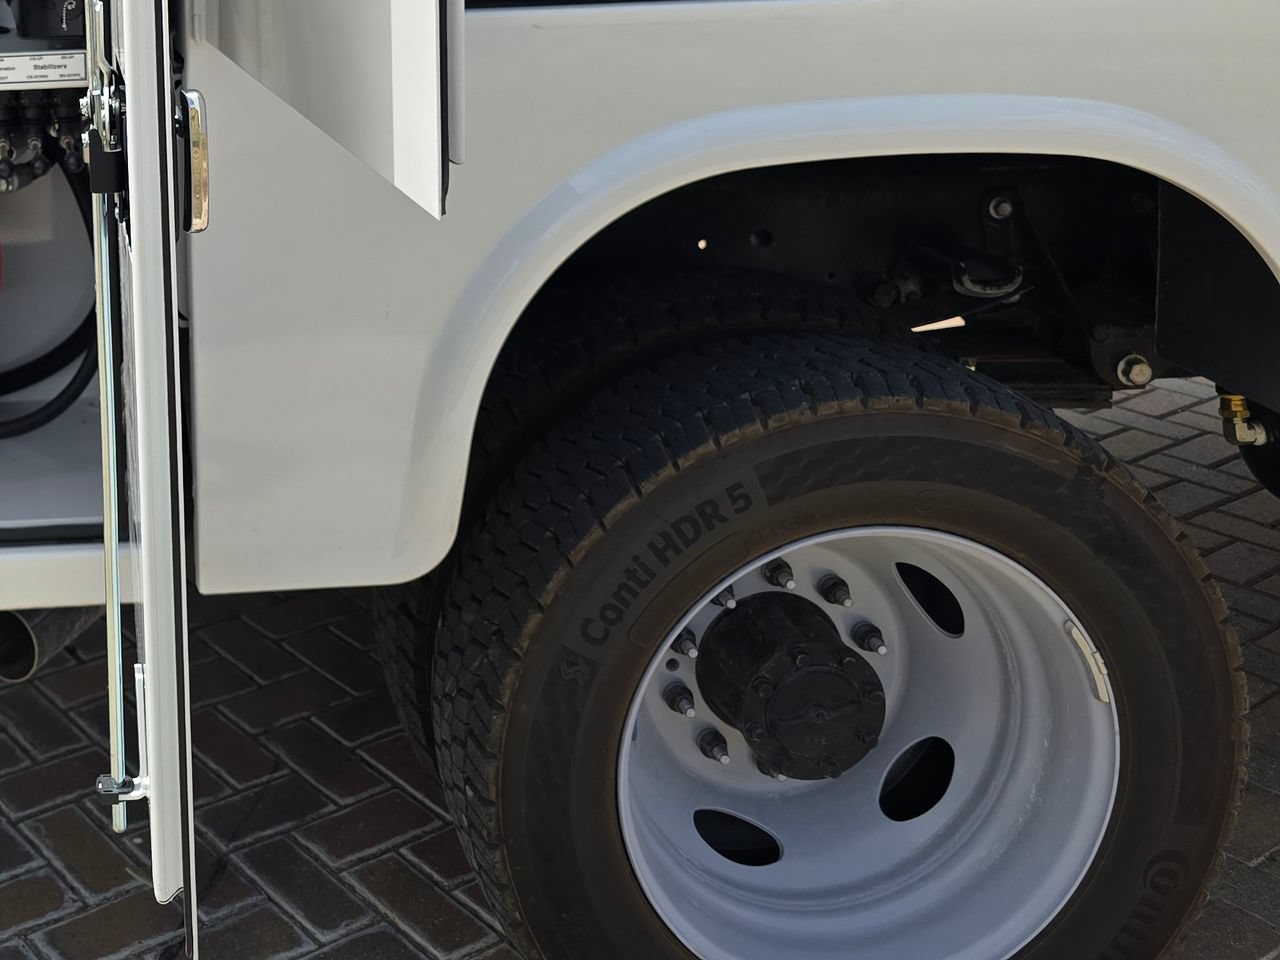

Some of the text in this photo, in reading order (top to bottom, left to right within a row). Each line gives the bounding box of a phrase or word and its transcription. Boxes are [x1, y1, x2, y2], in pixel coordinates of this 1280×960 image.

[33, 63, 67, 71] Stabilizers
[580, 554, 657, 647] Conti
[647, 498, 729, 569] HDR
[724, 481, 753, 515] 5
